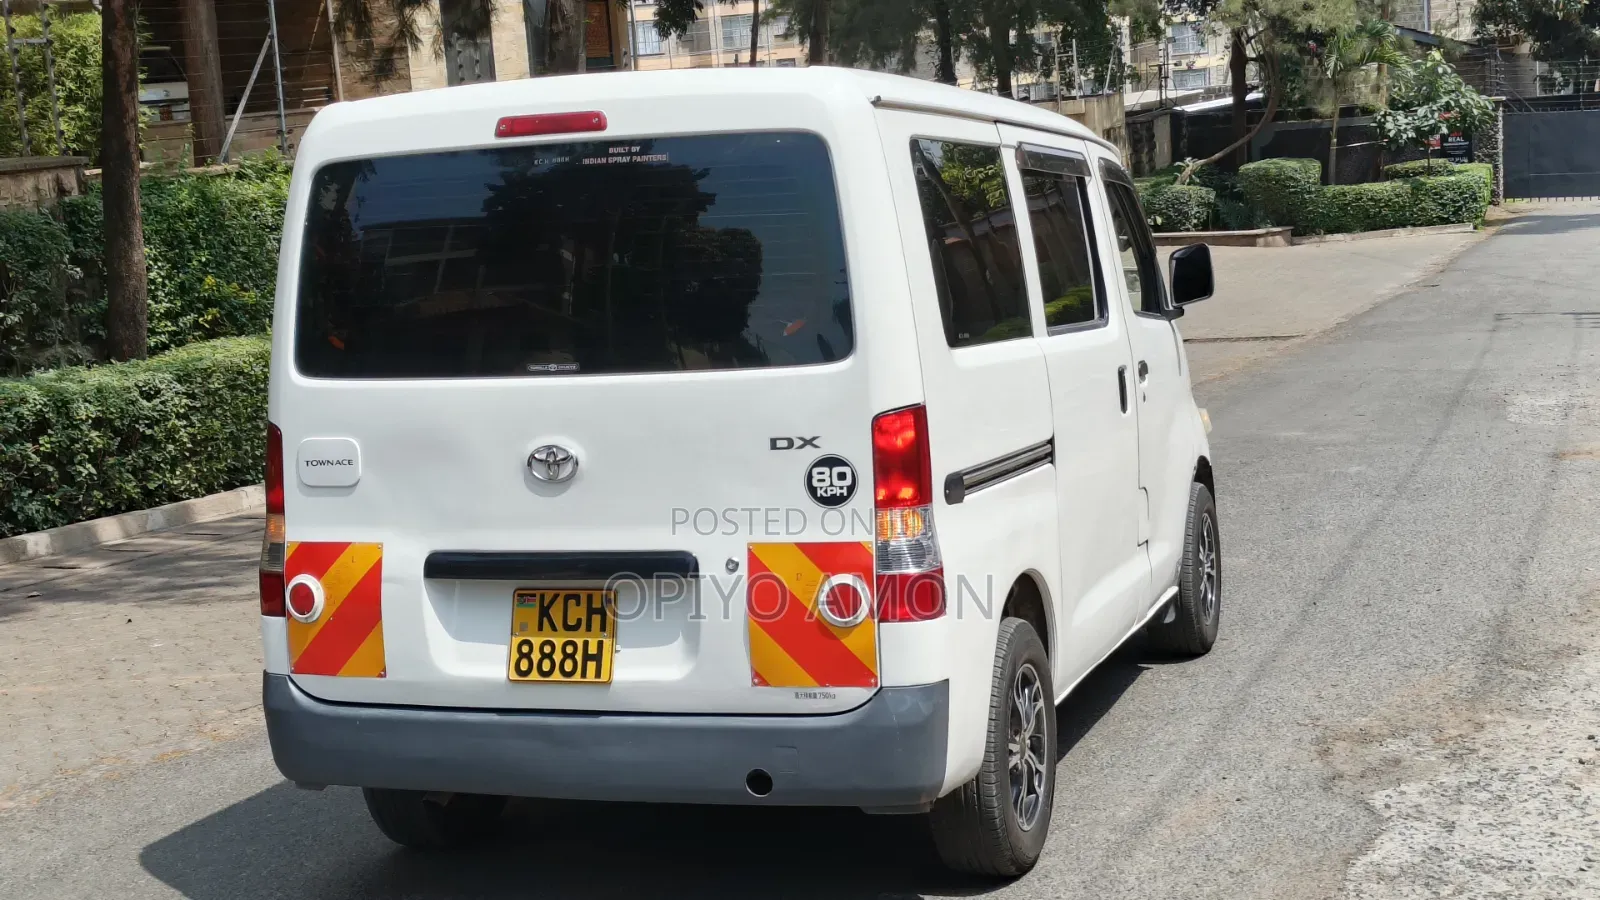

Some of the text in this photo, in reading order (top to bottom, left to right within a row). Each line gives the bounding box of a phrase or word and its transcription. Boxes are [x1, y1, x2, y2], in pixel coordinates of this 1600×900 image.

[608, 146, 630, 154] BUILT
[582, 154, 667, 165] INDIAN SPRAY PAINTERS
[769, 435, 822, 450] DX
[811, 466, 852, 487] 80
[816, 486, 848, 497] KPH
[537, 593, 608, 632] KCH
[514, 639, 604, 679] 888H
